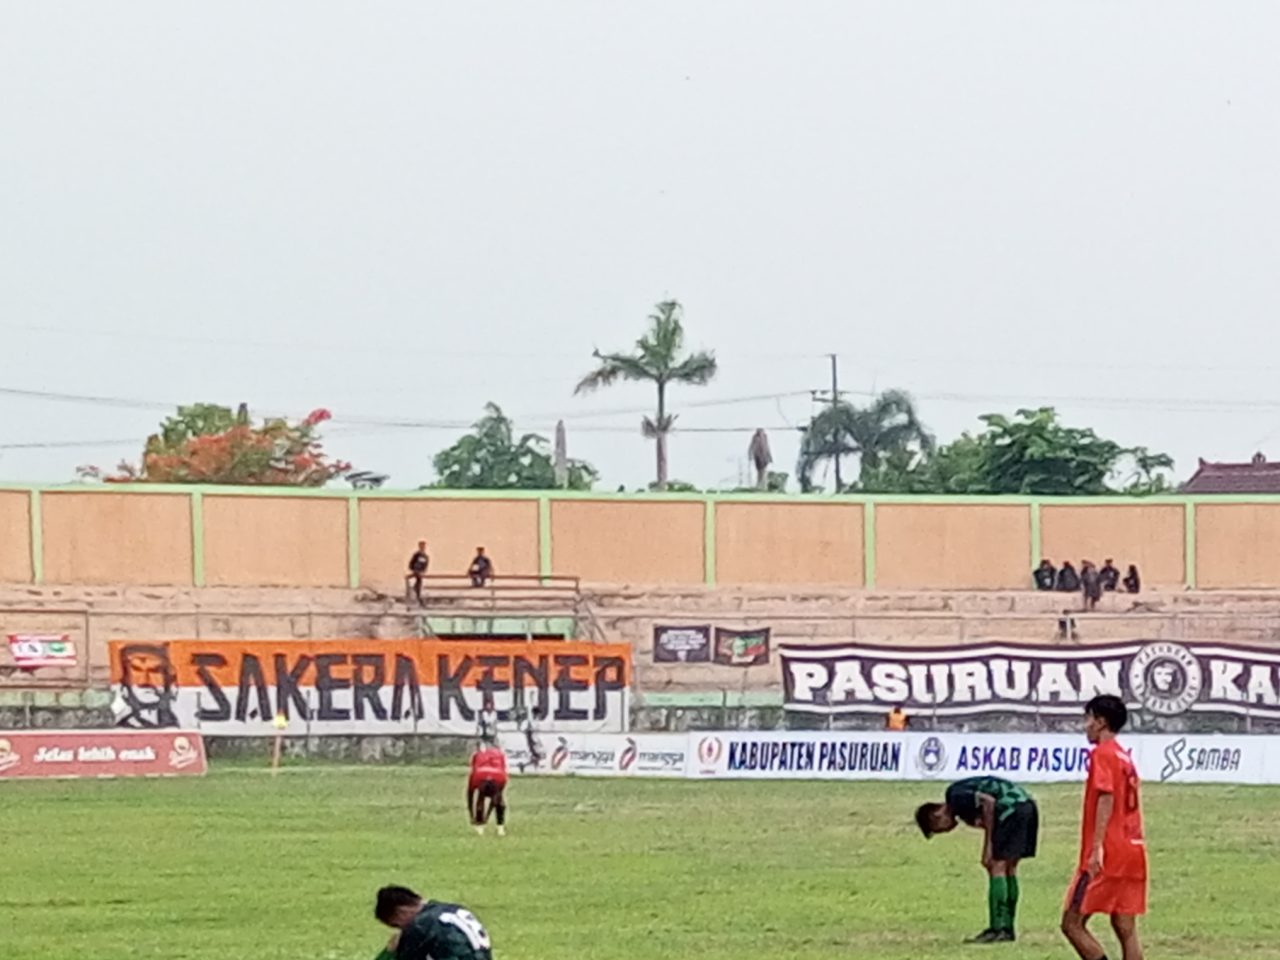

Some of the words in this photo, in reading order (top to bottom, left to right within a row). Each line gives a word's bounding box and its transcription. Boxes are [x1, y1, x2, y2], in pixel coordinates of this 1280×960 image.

[191, 653, 424, 722] SAKERA
[437, 654, 626, 721] KENEP
[789, 659, 1122, 703] PASURUAN
[728, 742, 816, 770] KABUPATEN
[818, 742, 901, 771] PASURUAN
[956, 746, 1021, 771] ASKAB
[1185, 749, 1241, 771] SAMBA
